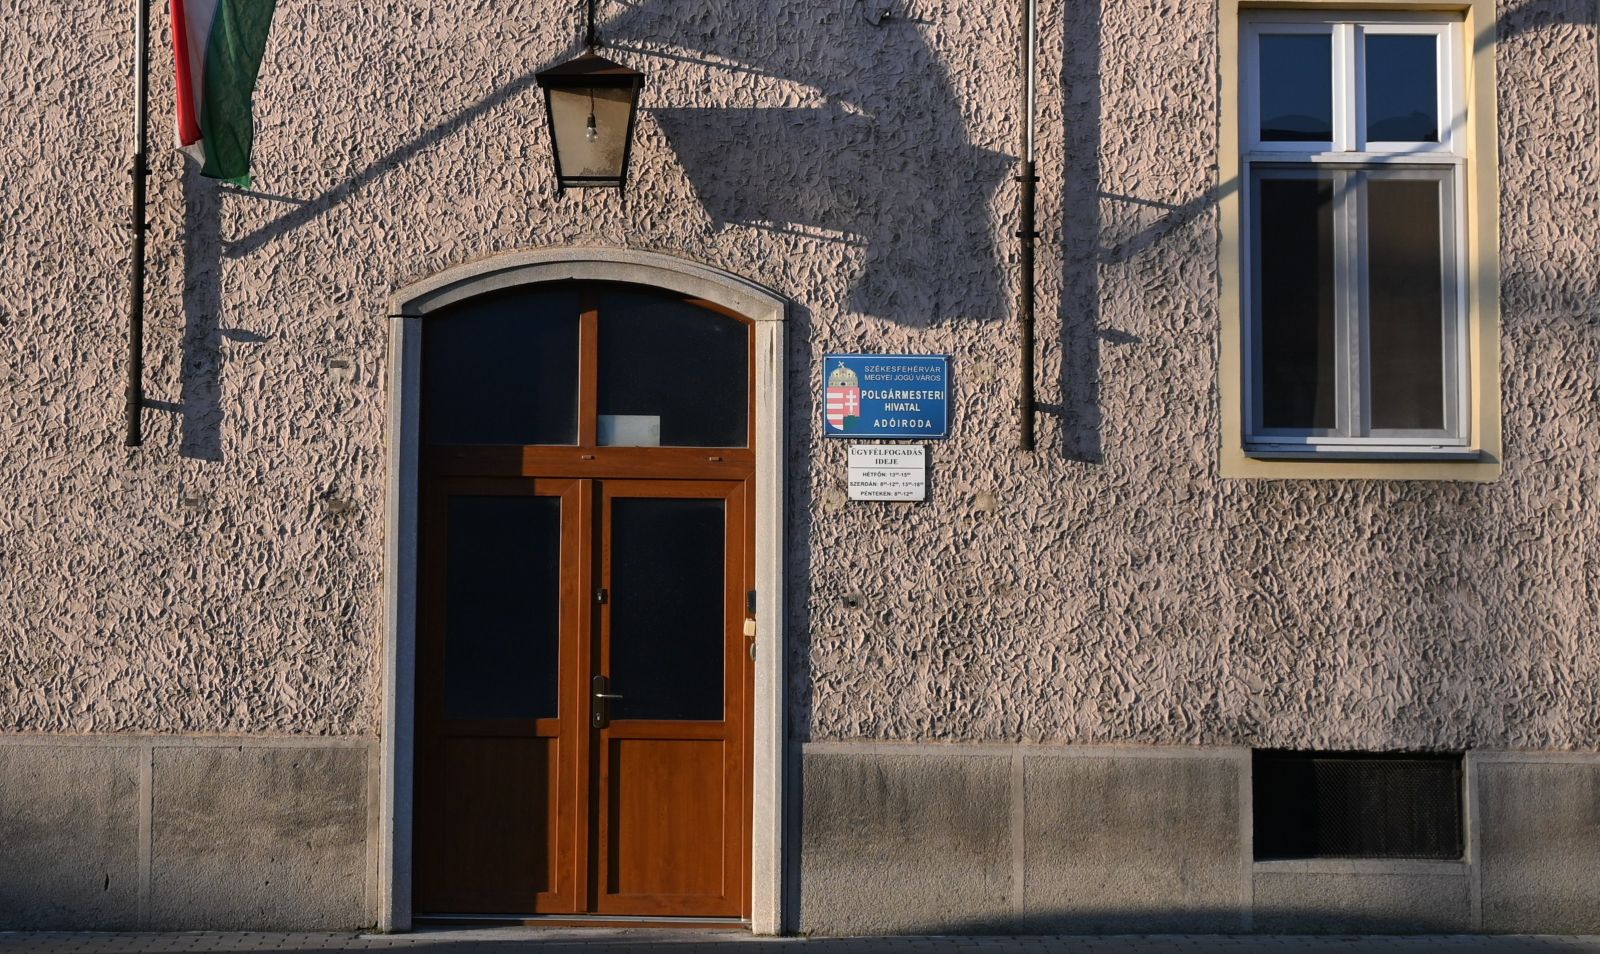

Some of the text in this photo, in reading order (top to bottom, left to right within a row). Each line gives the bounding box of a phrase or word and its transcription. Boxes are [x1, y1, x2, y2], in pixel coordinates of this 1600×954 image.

[864, 365, 941, 373] SZÉKESFEHÉRVÁR
[861, 388, 944, 400] POLGÁRMESTERI
[884, 403, 920, 412] HIVATAL
[874, 418, 932, 428] ADÓIRODA
